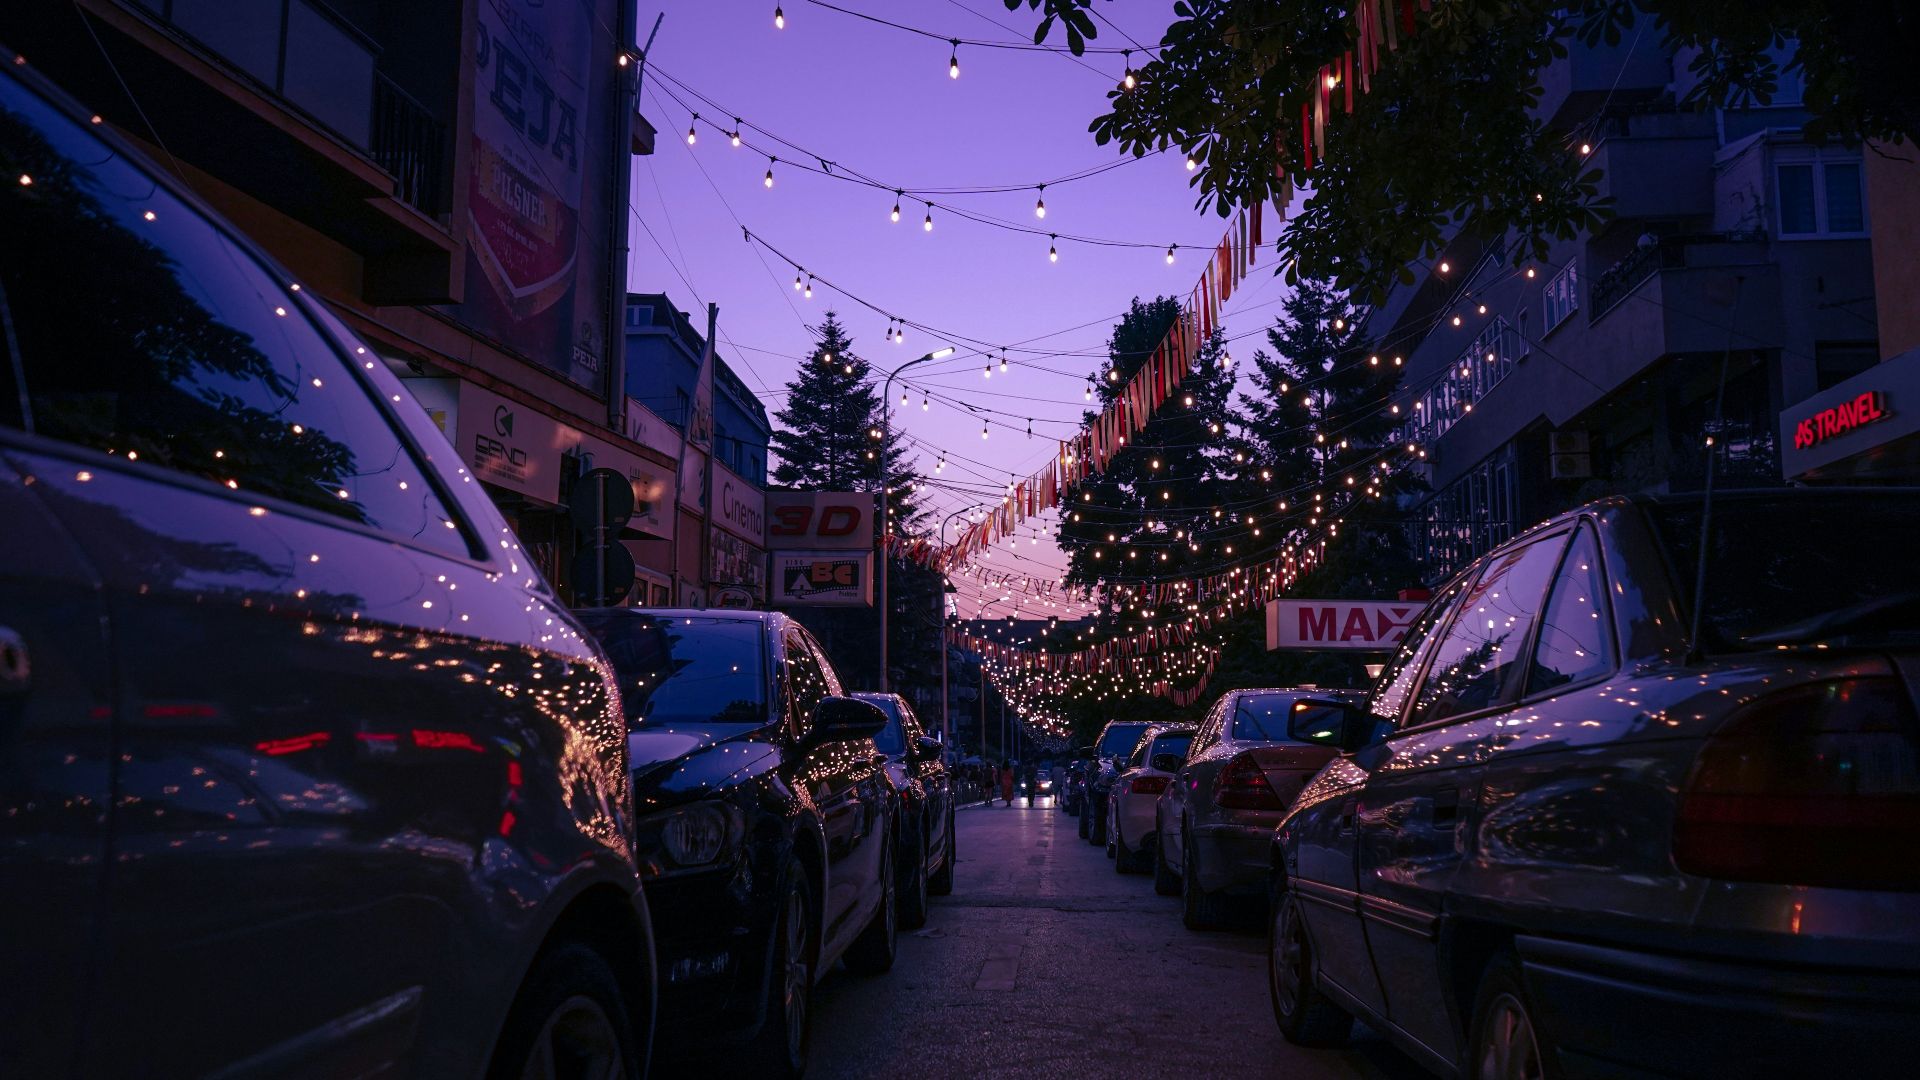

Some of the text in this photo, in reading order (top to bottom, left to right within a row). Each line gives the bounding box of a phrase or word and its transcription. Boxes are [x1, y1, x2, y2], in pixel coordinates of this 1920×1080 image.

[492, 165, 547, 226] PILSNER
[572, 345, 598, 373] PEJA
[1814, 391, 1882, 442] TRAVEL
[723, 482, 762, 536] Cinema
[771, 505, 861, 536] 3D
[790, 561, 853, 590] ABC
